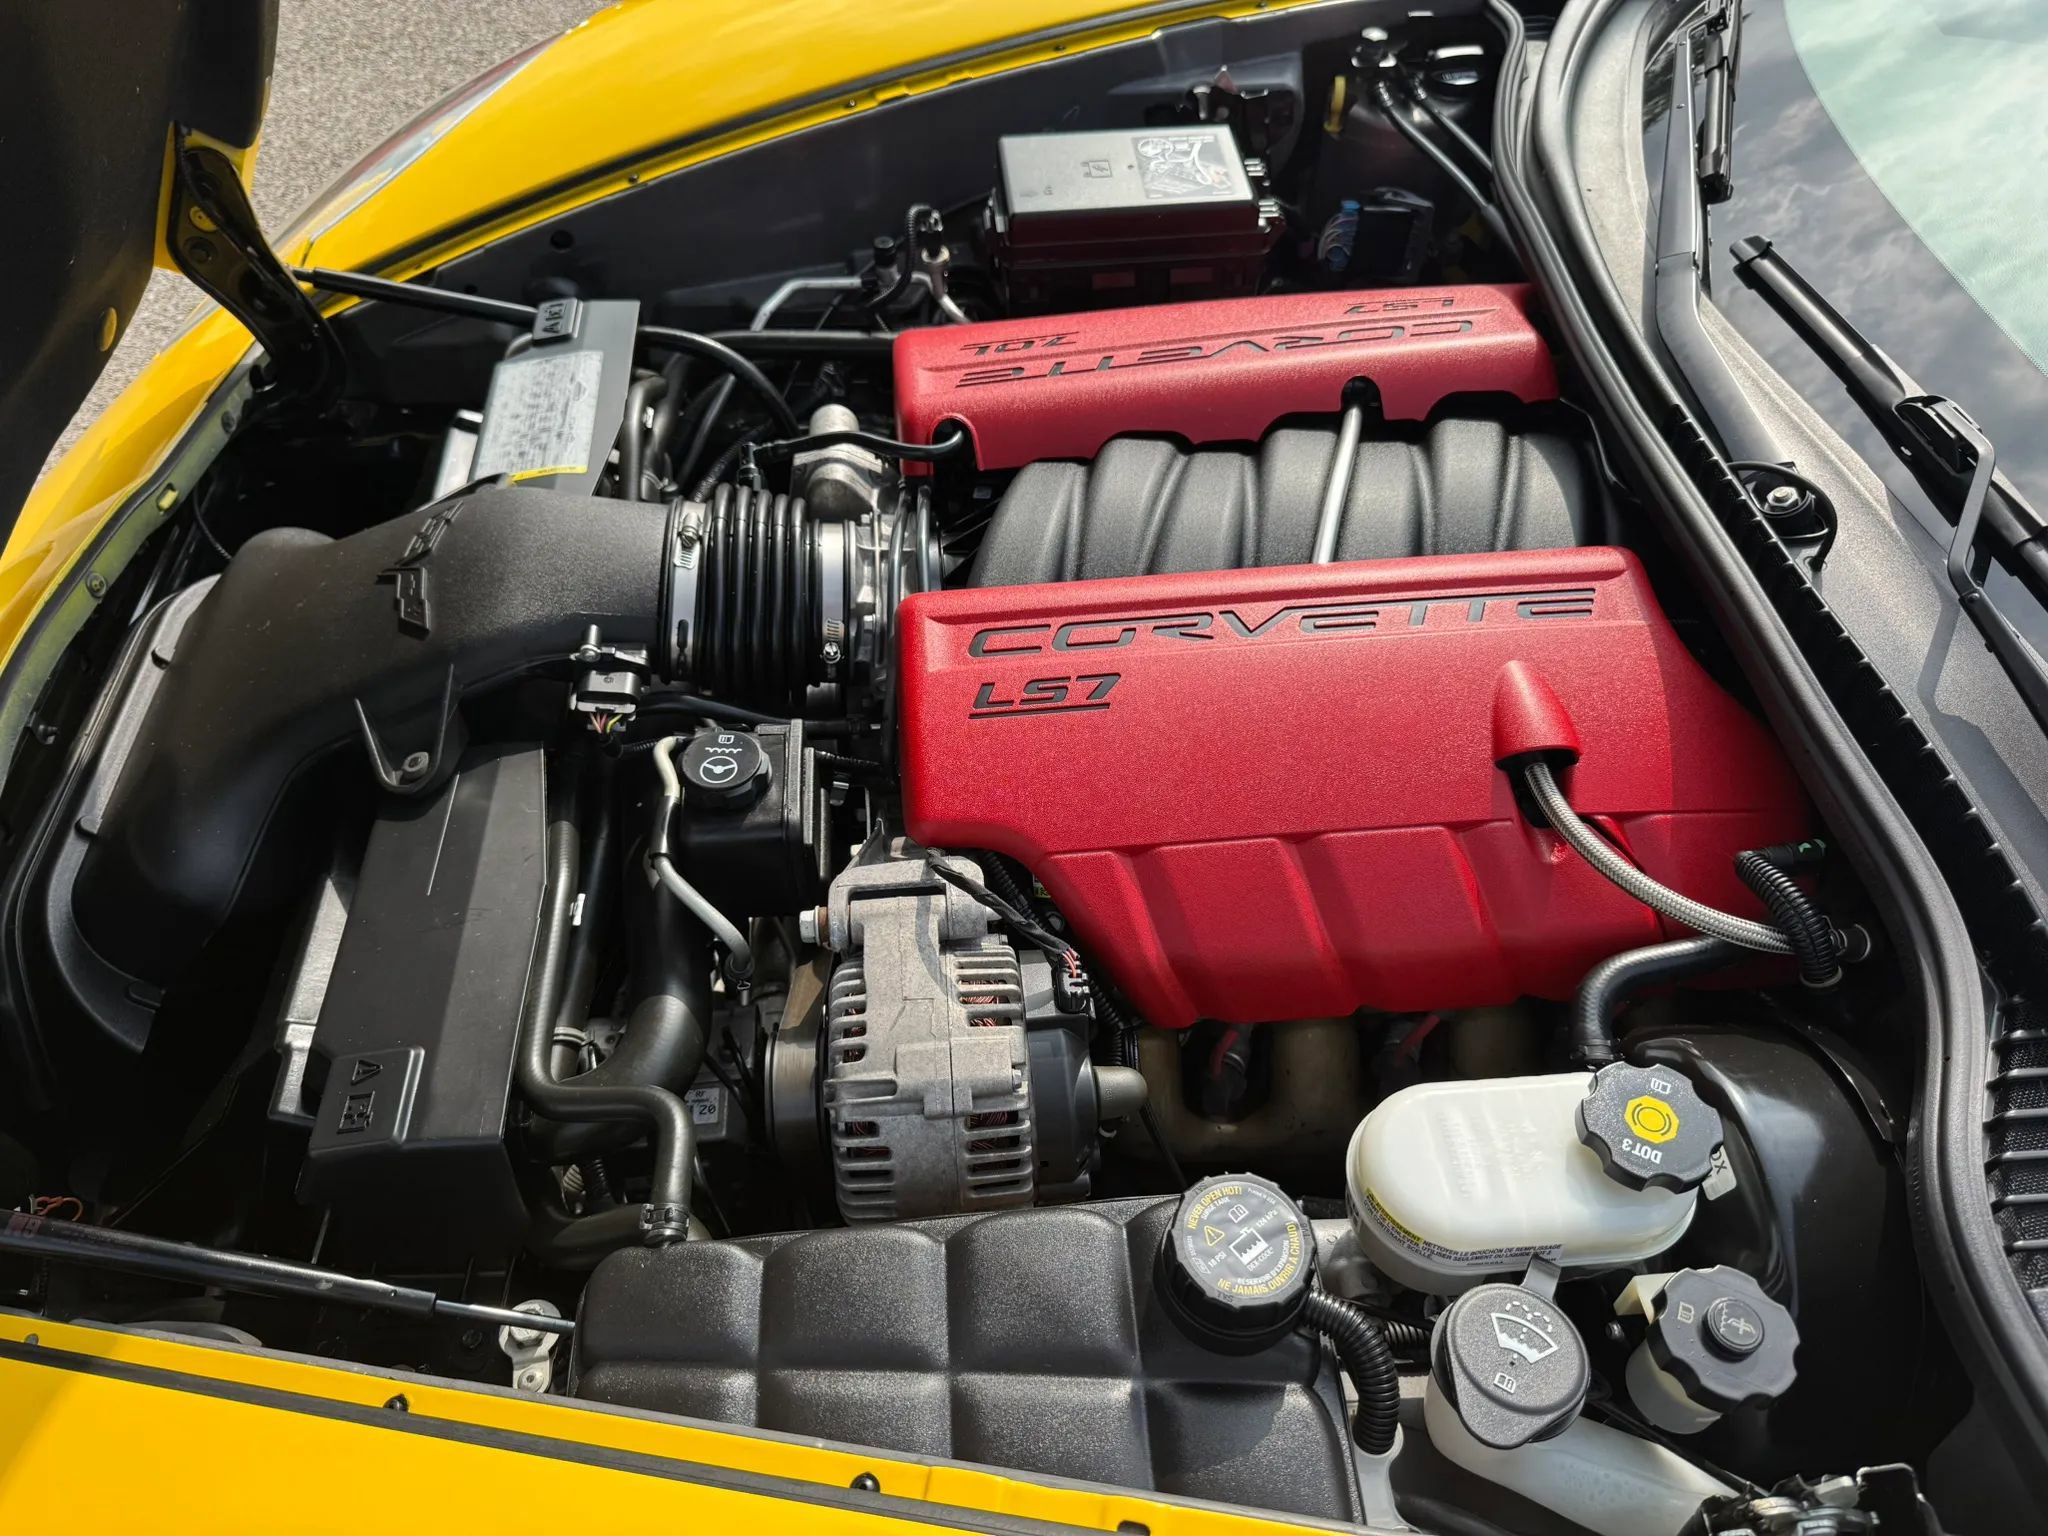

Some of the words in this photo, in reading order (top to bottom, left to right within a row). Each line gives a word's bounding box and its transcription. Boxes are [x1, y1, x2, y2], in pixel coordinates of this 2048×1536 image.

[956, 319, 1473, 389] CORVETTE
[968, 587, 1596, 658] CORVETTE
[970, 672, 1122, 711] LS7
[1622, 1138, 1632, 1151] 3
[1632, 1143, 1663, 1164] DOT
[1187, 1204, 1204, 1230] NEVER
[1201, 1190, 1223, 1207] OPEN
[1222, 1186, 1242, 1196] HOT!
[1214, 1251, 1227, 1264] PSI
[1217, 1277, 1230, 1291] NE
[1231, 1284, 1269, 1296] JAMAIS
[1269, 1265, 1295, 1290] OUVRIR
[1286, 1221, 1301, 1257] CHAUD!
[1423, 1240, 1459, 1257] NETTOYER
[1470, 1248, 1504, 1257] BOUCHON
[1515, 1244, 1562, 1252] REMPLISSAGE
[1452, 1254, 1493, 1262] SEULEMENT
